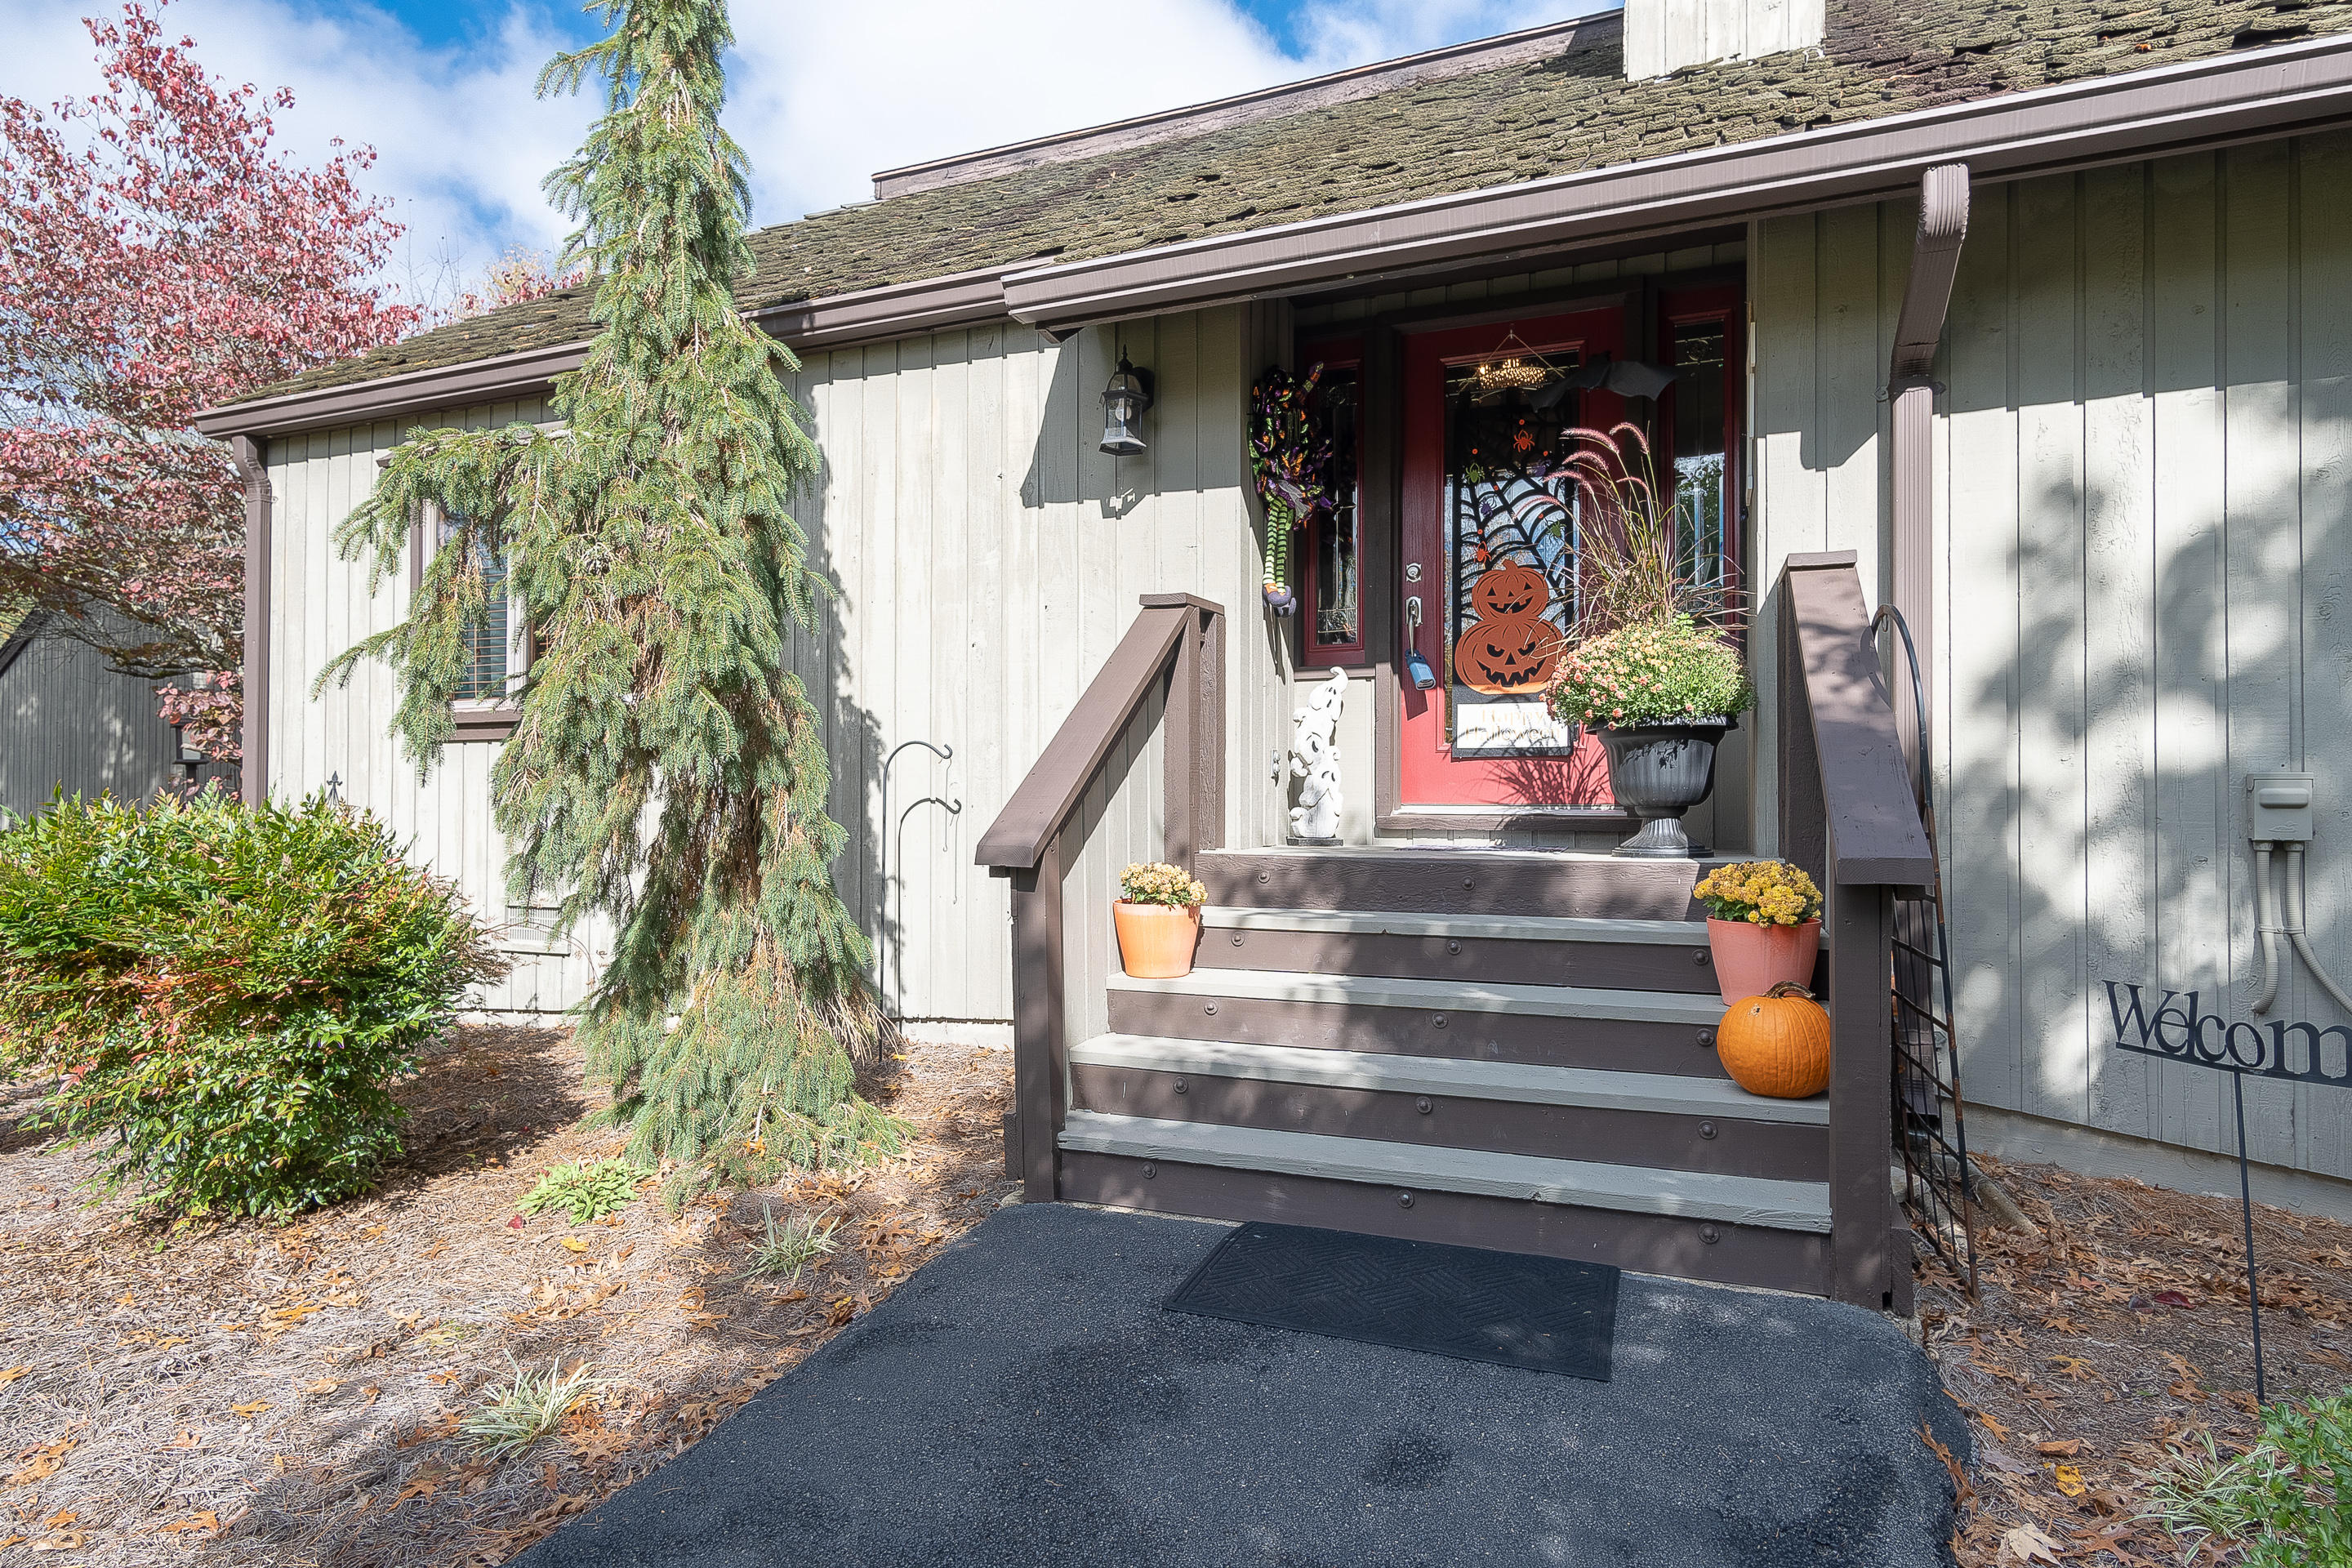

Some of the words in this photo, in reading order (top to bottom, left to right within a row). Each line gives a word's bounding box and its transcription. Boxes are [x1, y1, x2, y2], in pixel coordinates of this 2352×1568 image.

[1481, 709, 1545, 726] Happy
[1465, 724, 1561, 741] Halloween
[2101, 979, 2352, 1077] Welcom
